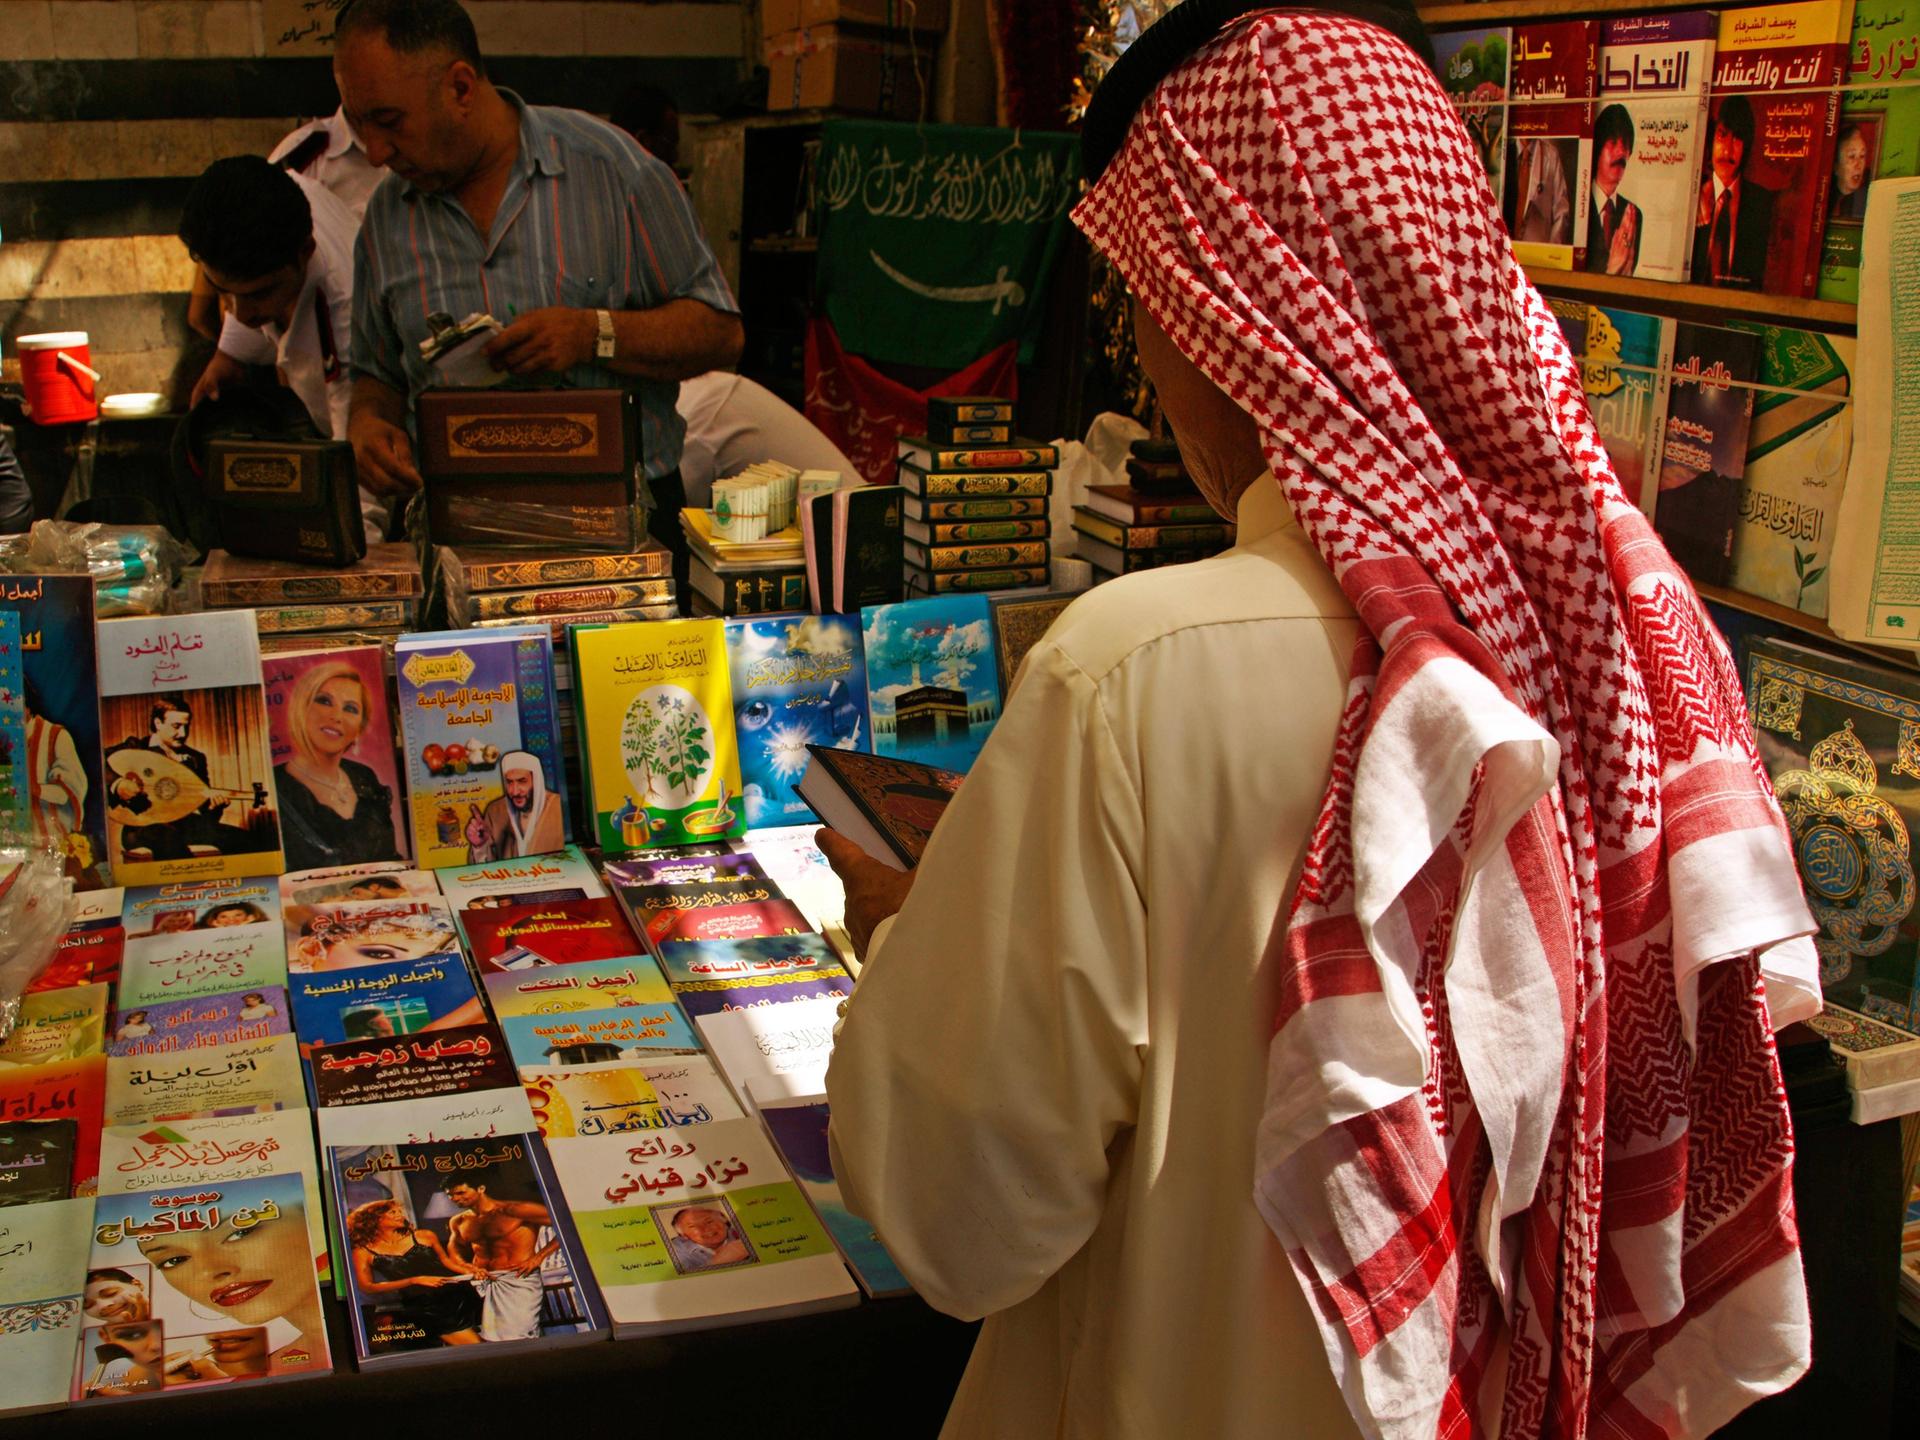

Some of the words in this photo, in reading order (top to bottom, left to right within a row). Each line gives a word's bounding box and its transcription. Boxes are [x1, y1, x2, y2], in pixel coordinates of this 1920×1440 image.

[1644, 18, 1670, 31] يوسف
[1735, 17, 1767, 34] الشرفاء
[1768, 17, 1797, 32] يوسف
[1513, 35, 1553, 61] عال
[1871, 36, 1919, 80] نزار
[1784, 51, 1823, 85] أنت
[1537, 75, 1567, 99] نفسك
[1647, 136, 1666, 148] طريقة
[1765, 126, 1812, 143] بالطريقة
[1763, 146, 1809, 162] الصينية
[1738, 488, 1779, 528] بالقرآن
[1770, 500, 1824, 544] التداوي
[665, 648, 707, 670] التداوي
[416, 688, 470, 709] الإسلامية
[471, 683, 515, 704] الأدوية
[447, 709, 493, 728] الجامعة
[312, 903, 431, 932] المكياج
[689, 960, 749, 976] الساعة
[753, 955, 820, 972] علامات
[358, 974, 399, 991] الزوجة
[400, 967, 445, 983] واجبات
[515, 976, 581, 994] النكت
[585, 968, 639, 990] أجمل
[303, 980, 355, 997] الجنسية
[533, 1022, 581, 1038] الشامية
[550, 1033, 600, 1048] الشعبية
[321, 1043, 409, 1073] زوجية
[411, 1035, 492, 1060] وصايا
[128, 1066, 192, 1086] ليلة
[195, 1057, 257, 1077] أول
[376, 1068, 400, 1079] العالم
[12, 1088, 77, 1119] المرأة
[583, 1096, 659, 1112] نصيحة
[577, 1111, 652, 1137] شعرك
[653, 1101, 714, 1130] لجمال
[203, 1140, 258, 1165] عسل
[236, 1137, 281, 1164] شهر
[433, 1144, 523, 1172] الزواج
[625, 1136, 698, 1165] روائع
[0, 1153, 46, 1171] تفس
[257, 1163, 274, 1176] لكل
[344, 1153, 429, 1182] المثالي
[690, 1156, 750, 1189] نزار
[125, 1175, 160, 1190] الزواج
[604, 1166, 685, 1203] قباني
[150, 1190, 222, 1208] موسوعة
[229, 1196, 281, 1229] فن
[95, 1205, 221, 1247] الماكياج
[0, 1240, 33, 1258] أجم
